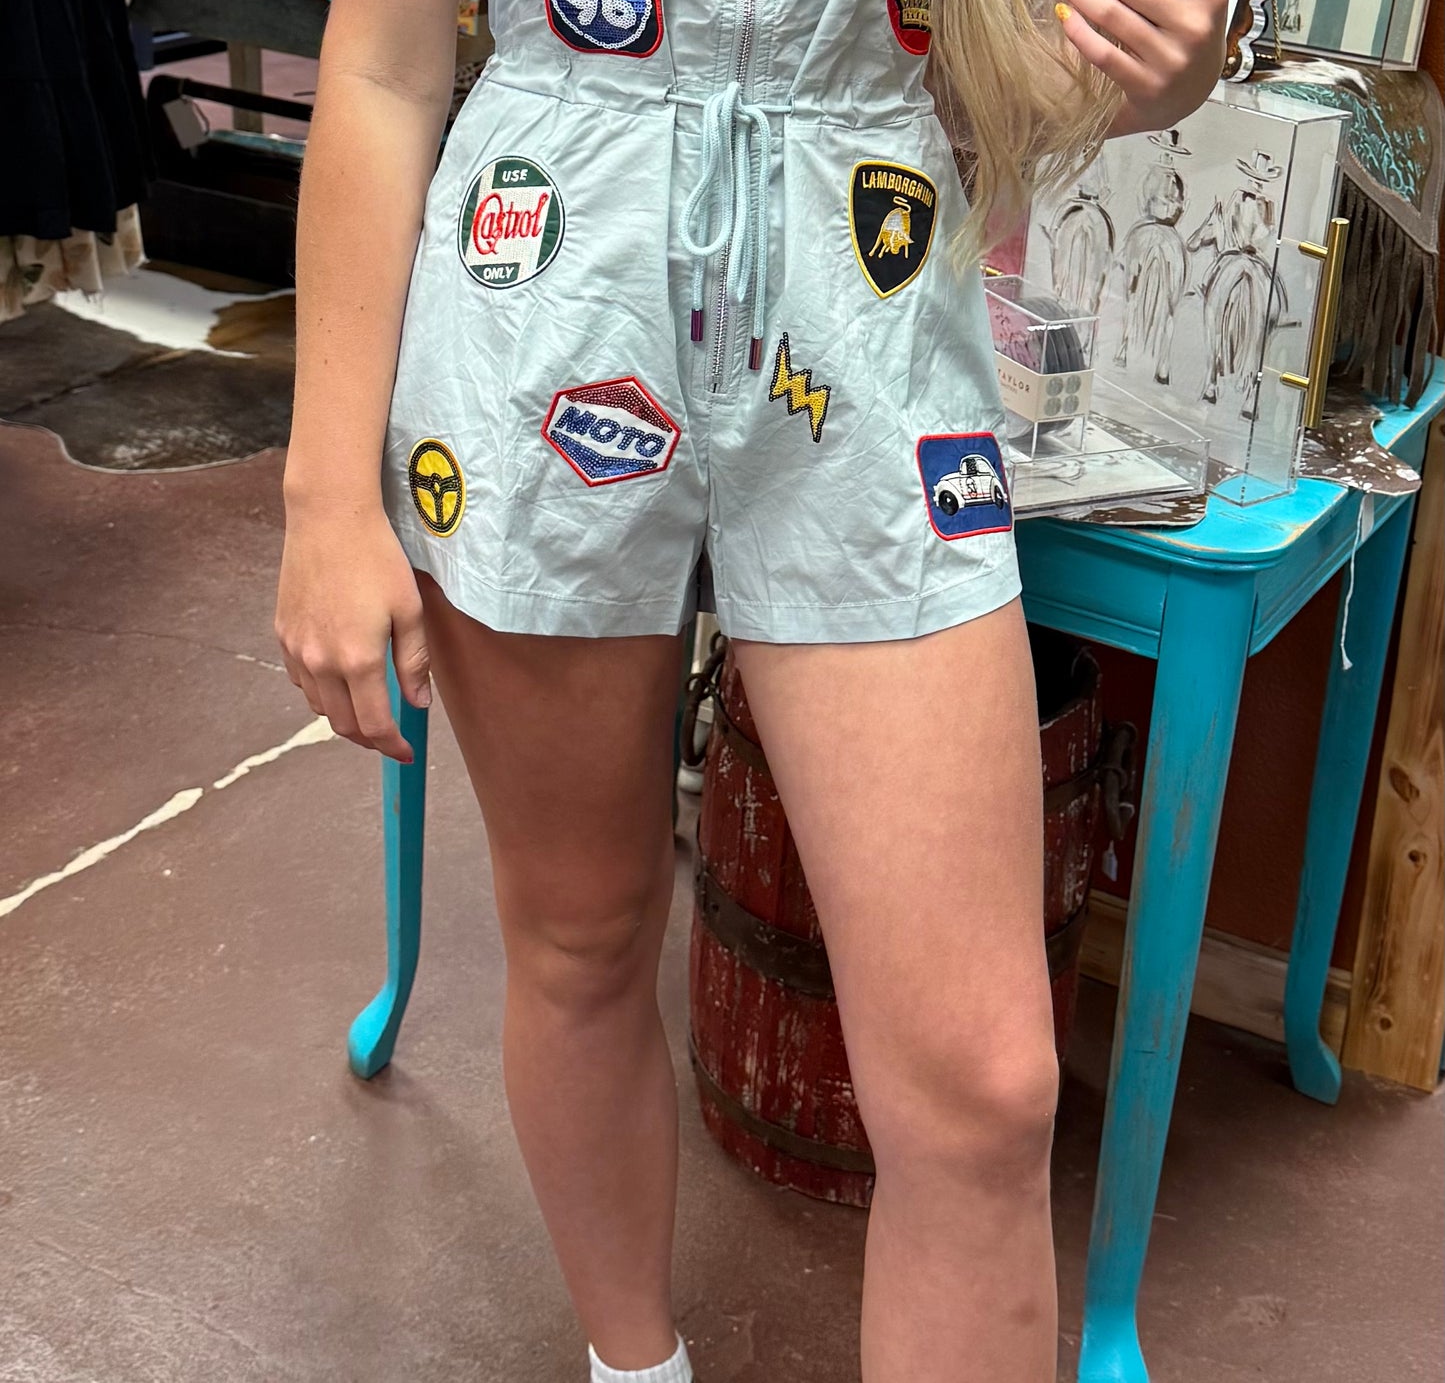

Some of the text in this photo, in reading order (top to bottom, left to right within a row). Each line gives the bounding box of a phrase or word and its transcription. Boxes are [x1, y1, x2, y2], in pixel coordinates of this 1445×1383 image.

[501, 168, 529, 183] USE
[861, 170, 935, 209] LAMBORGHINI
[472, 192, 550, 256] Castrol
[482, 266, 515, 281] ONLY
[554, 405, 667, 458] MOTO
